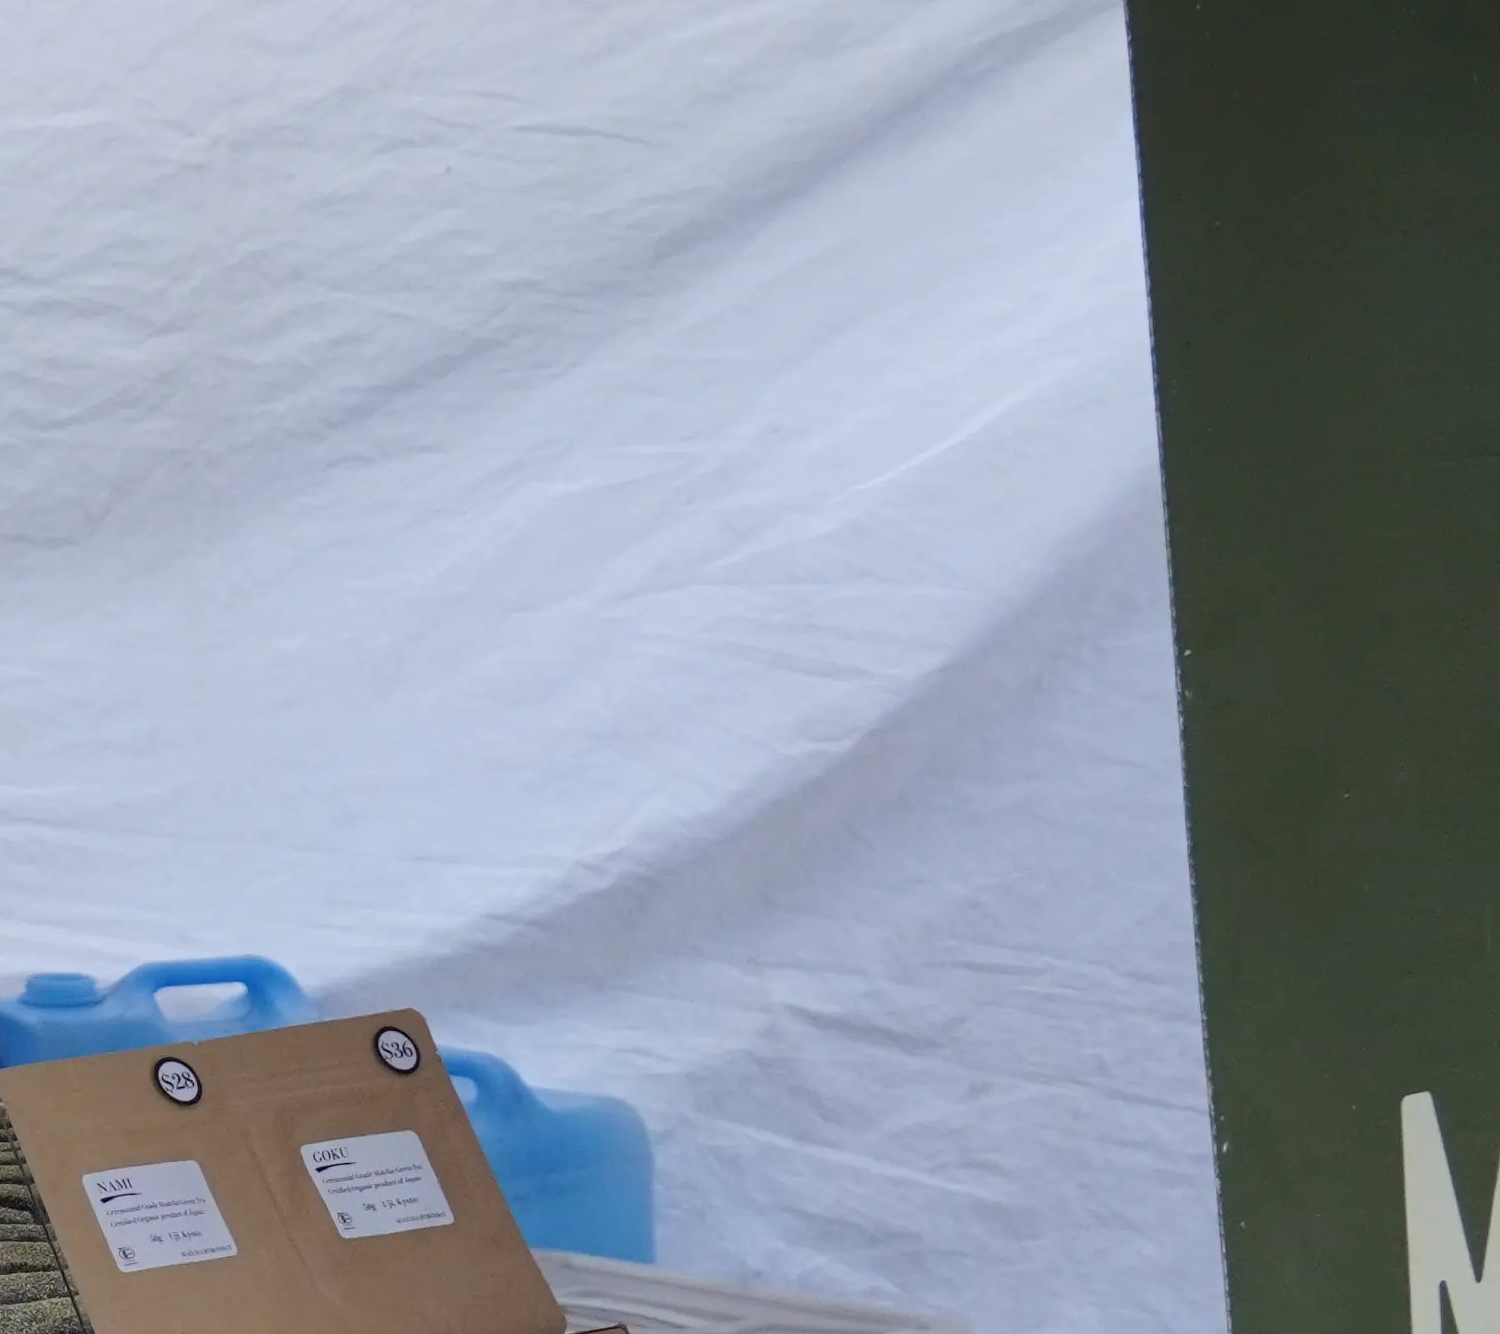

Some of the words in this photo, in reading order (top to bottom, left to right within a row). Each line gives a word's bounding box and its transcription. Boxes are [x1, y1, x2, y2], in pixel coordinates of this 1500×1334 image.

[380, 1040, 414, 1061] $36
[160, 1071, 196, 1094] $28
[312, 1146, 350, 1163] GOKU
[97, 1177, 133, 1194] NAMI
